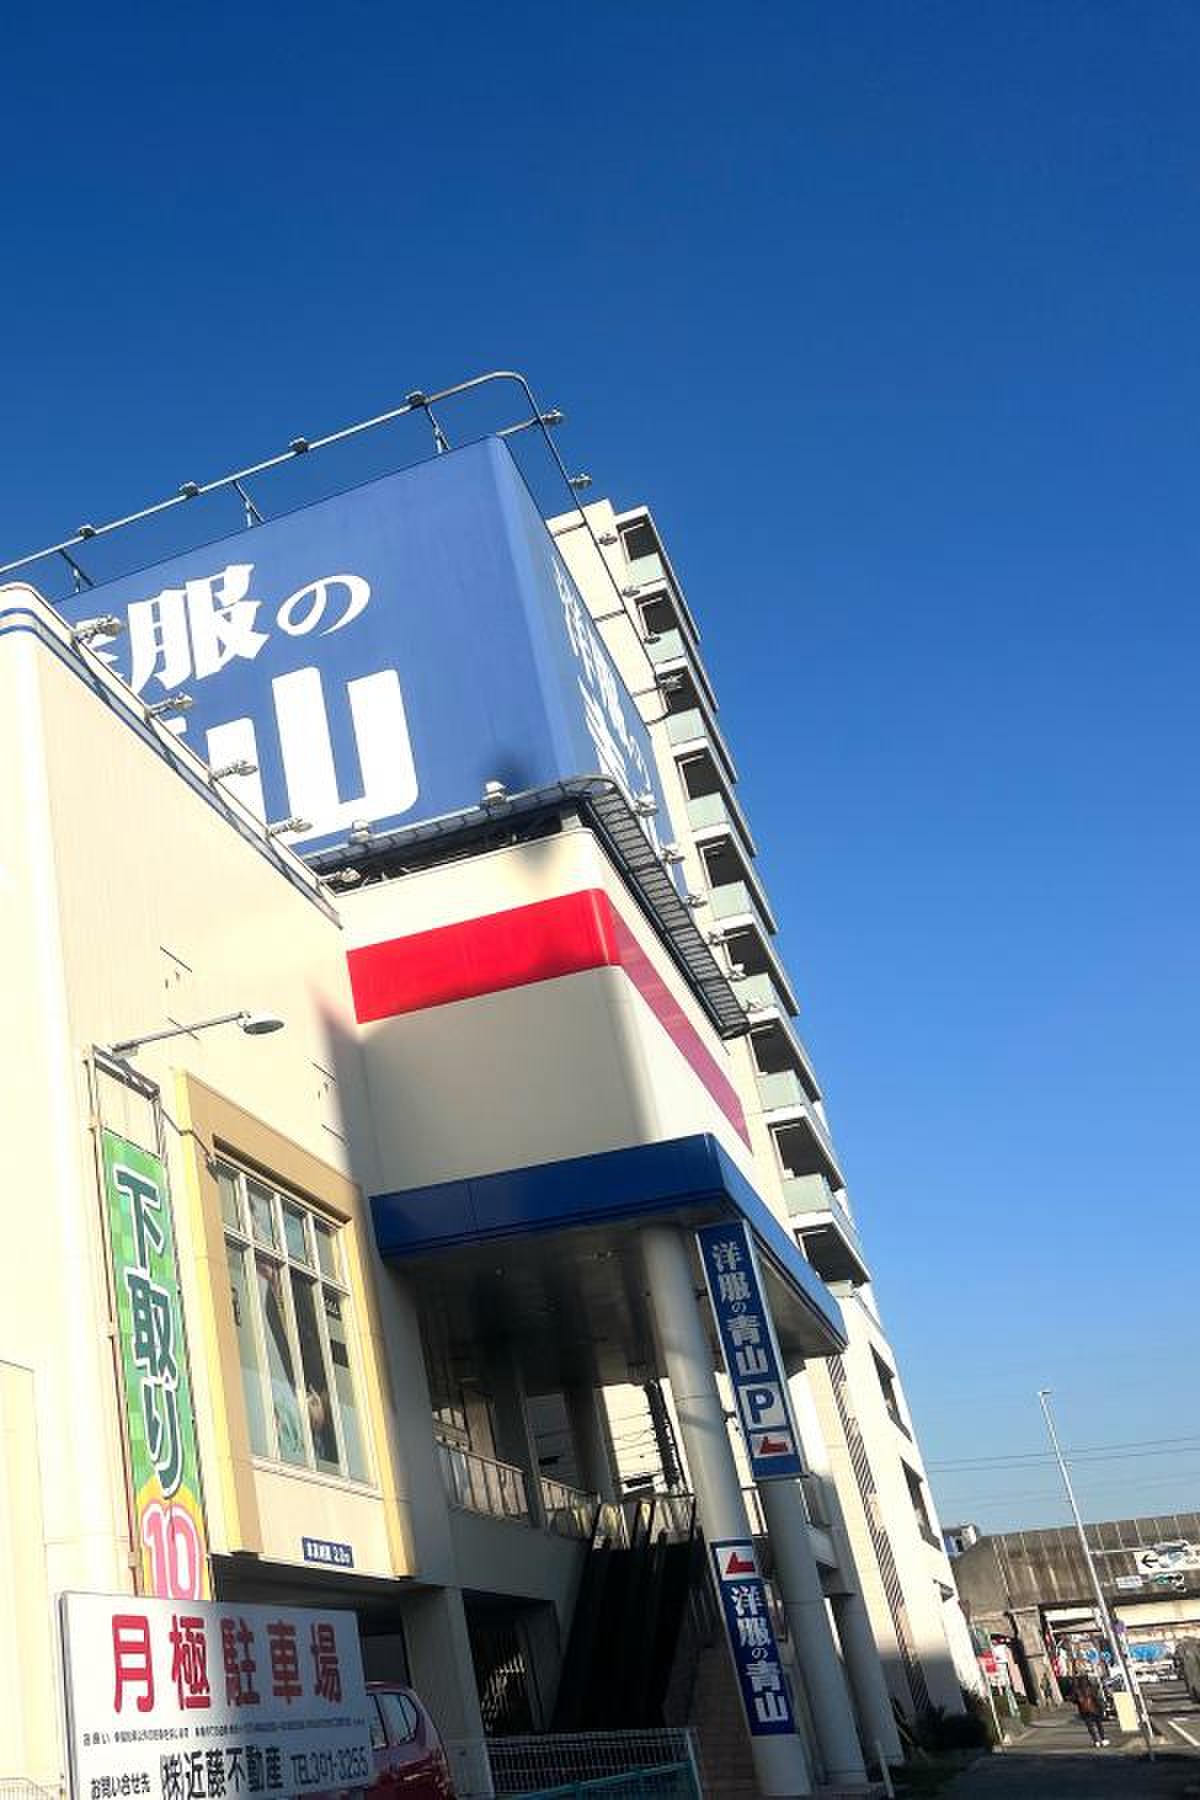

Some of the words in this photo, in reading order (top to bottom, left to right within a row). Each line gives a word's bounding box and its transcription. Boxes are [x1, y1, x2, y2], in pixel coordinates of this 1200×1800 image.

[162, 668, 419, 843] 山
[113, 1165, 182, 1498] 下取り
[712, 1241, 769, 1377] 洋服の青山
[747, 1388, 775, 1425] P
[142, 1503, 199, 1600] 10
[111, 1613, 343, 1713] 月極駐車場
[731, 1585, 789, 1723] 洋服の青山
